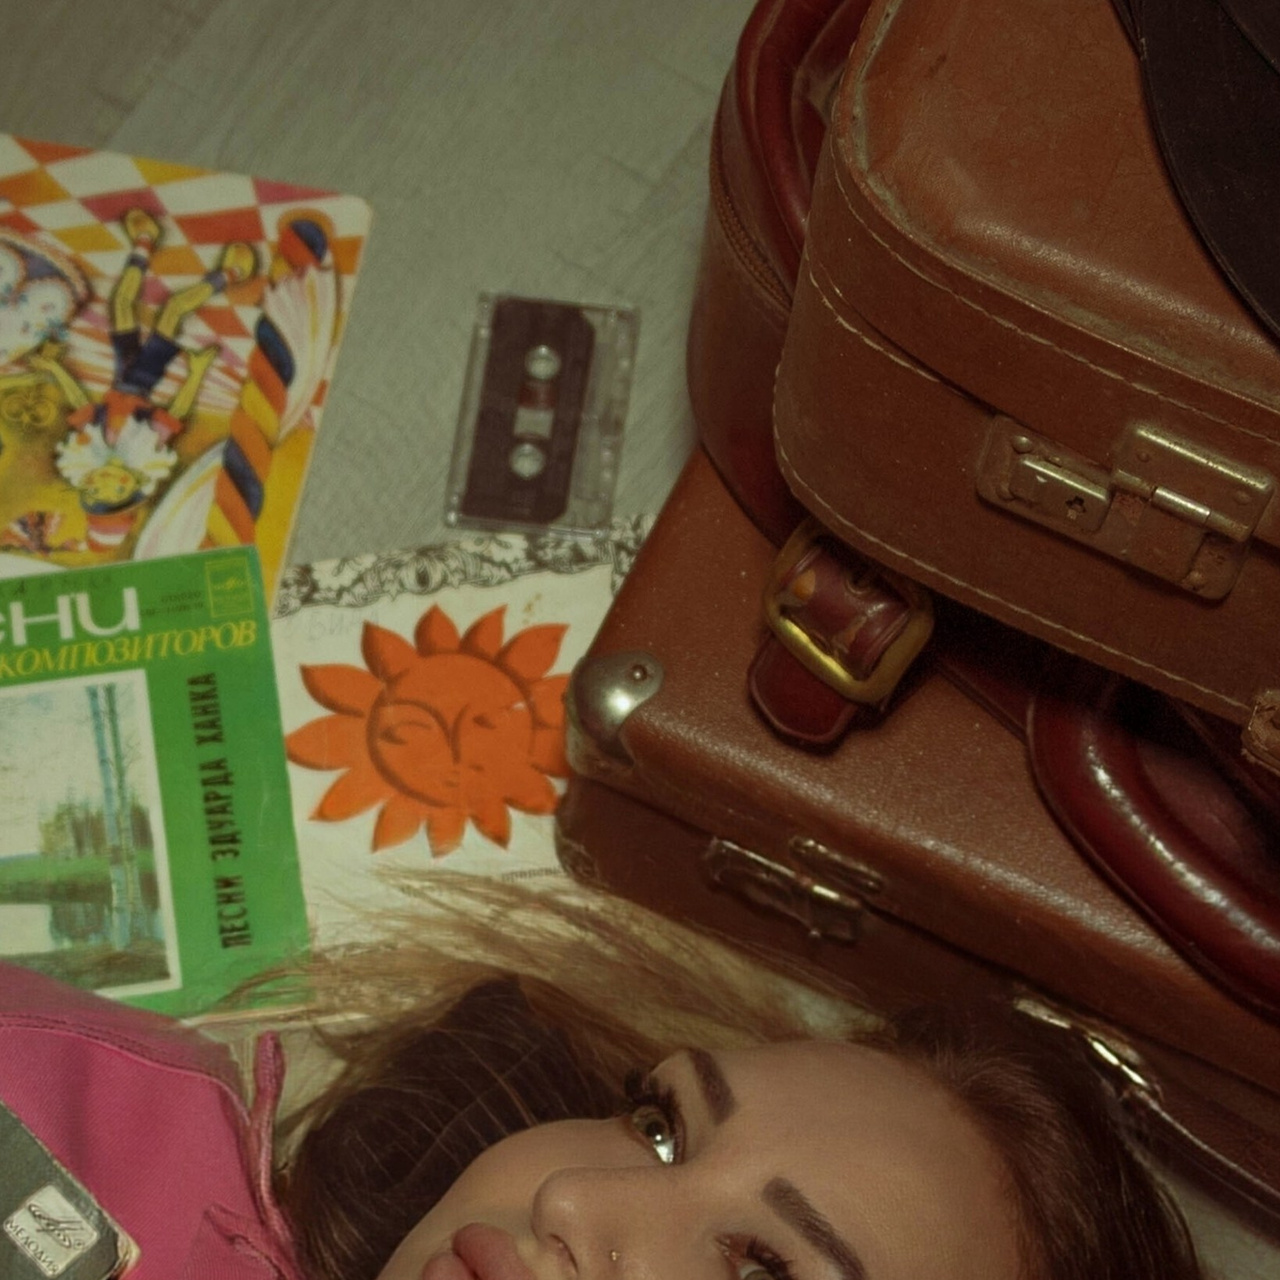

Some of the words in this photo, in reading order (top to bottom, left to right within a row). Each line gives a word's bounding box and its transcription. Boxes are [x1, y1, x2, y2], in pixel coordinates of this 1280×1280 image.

[187, 672, 223, 745] ХАНКА
[199, 759, 242, 862] ЭДУАРДА
[214, 876, 251, 948] ПЕСНИ
[6, 1219, 61, 1274] МЕЛОДИЯ
